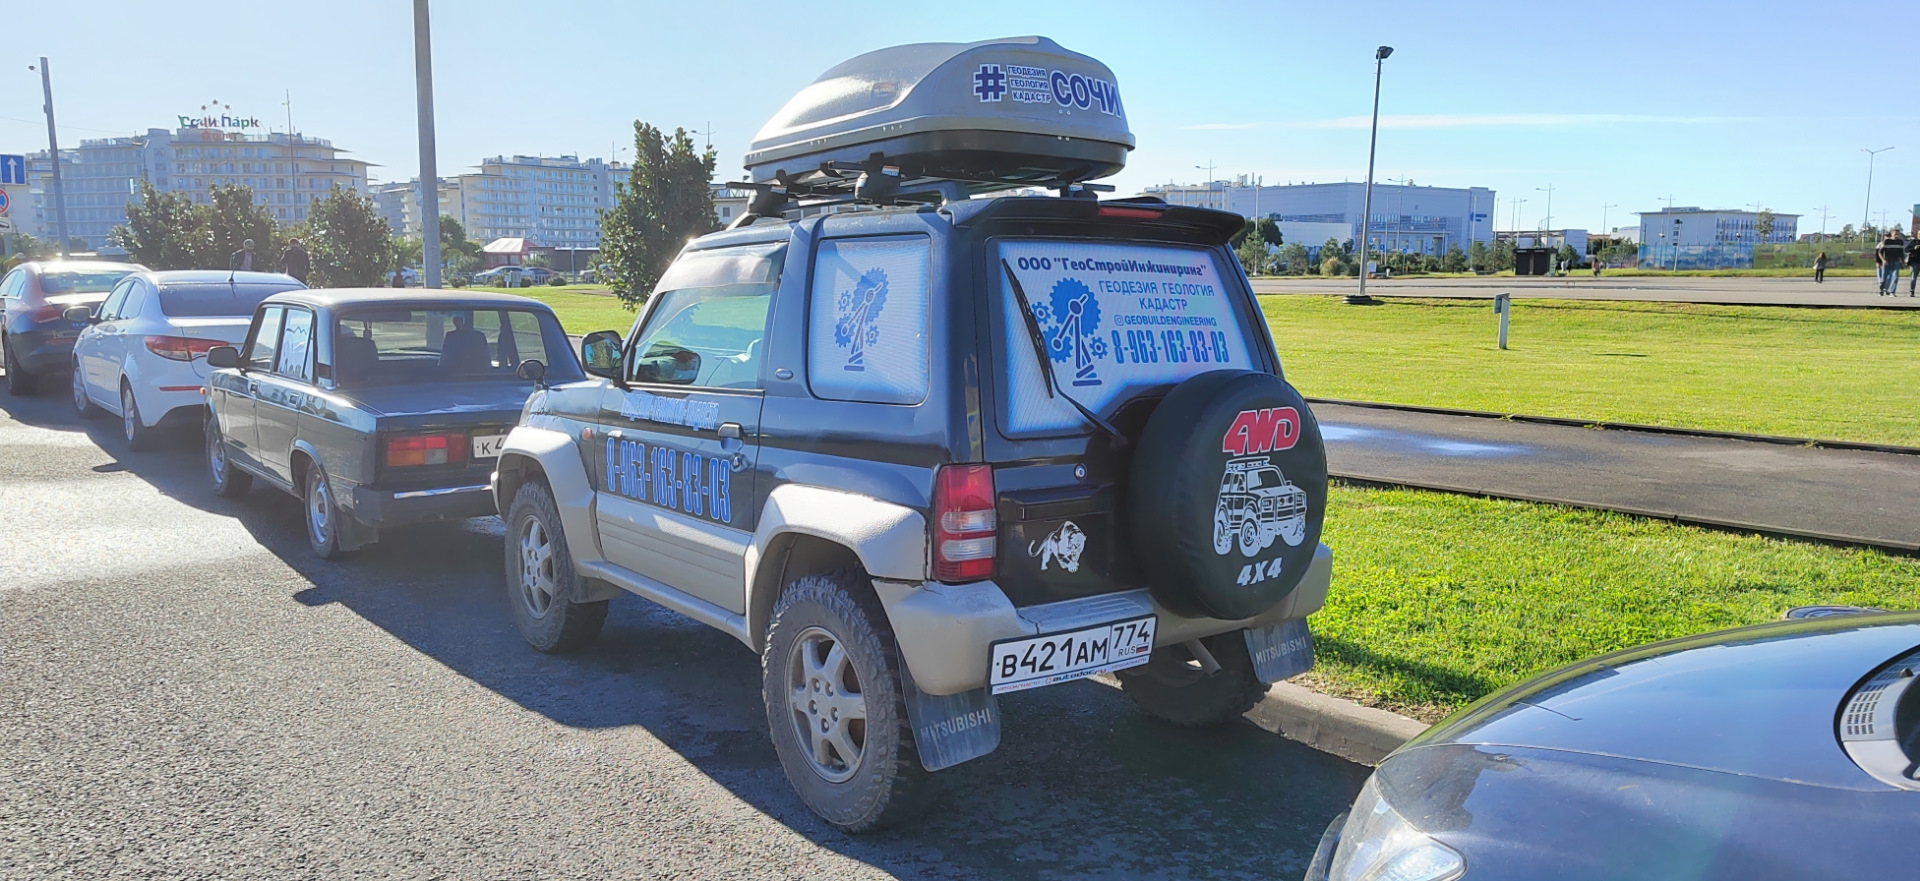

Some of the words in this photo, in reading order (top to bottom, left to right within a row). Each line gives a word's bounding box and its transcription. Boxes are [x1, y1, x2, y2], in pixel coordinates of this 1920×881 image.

[1006, 65, 1047, 77] ГЕОДЕЗИЯ
[1009, 78, 1050, 90] ГЕОЛОГИЯ
[1012, 90, 1051, 103] КАДАСТР
[1050, 70, 1122, 118] СОЧИ
[1018, 257, 1051, 271] ООО
[1054, 258, 1207, 276] "ГеоСтройИнжиниринг"
[1099, 280, 1158, 294] ГЕОДЕЗИЯ
[1162, 283, 1215, 297] ГЕОЛОГИЯ
[1139, 298, 1188, 311] КАДАСТР
[1111, 330, 1230, 364] 8-963-163-83-03
[1222, 407, 1301, 456] 4WD
[606, 437, 731, 523] 8-963-163-83-03
[1236, 557, 1282, 587] 4X4
[1001, 637, 1109, 678] В421АМ
[1114, 621, 1151, 649] 774
[1118, 646, 1136, 657] RUS
[1255, 636, 1307, 665] MITSUBISHI
[920, 708, 992, 743] MITSUBISHI
